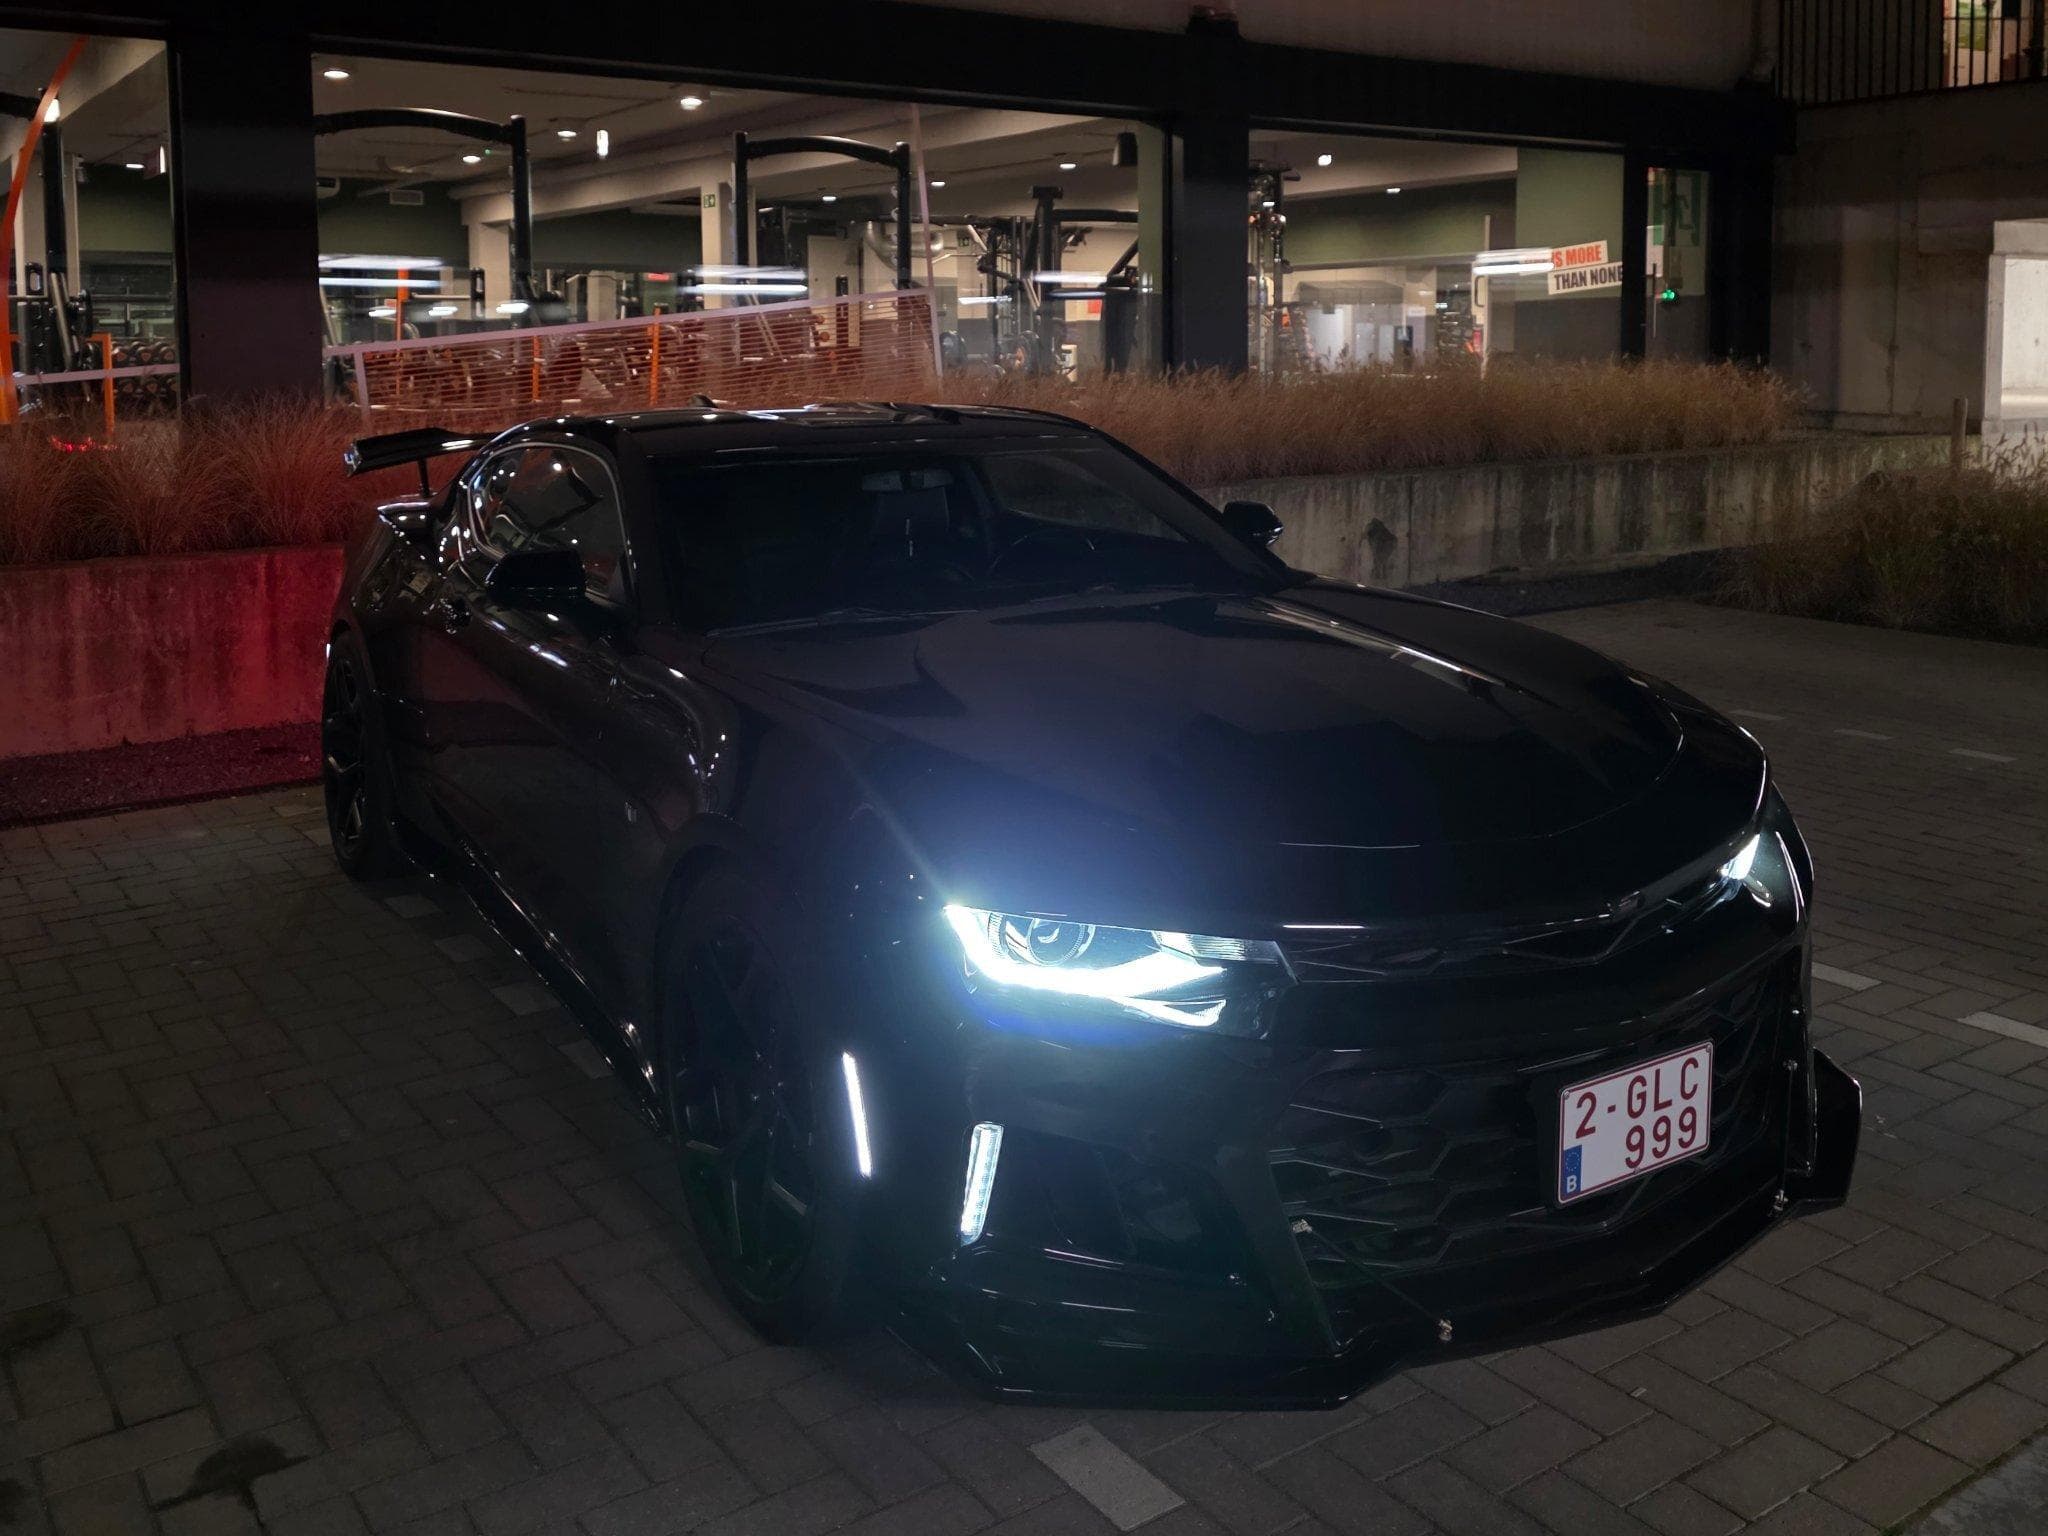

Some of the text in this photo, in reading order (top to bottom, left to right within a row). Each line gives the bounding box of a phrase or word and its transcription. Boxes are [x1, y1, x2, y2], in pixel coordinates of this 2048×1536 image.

[1566, 244, 1602, 266] MORE
[1554, 265, 1623, 290] THAN NONE
[1576, 1057, 1699, 1139] 2-GLC
[1625, 1106, 1697, 1168] 999
[1566, 1175, 1577, 1194] B
